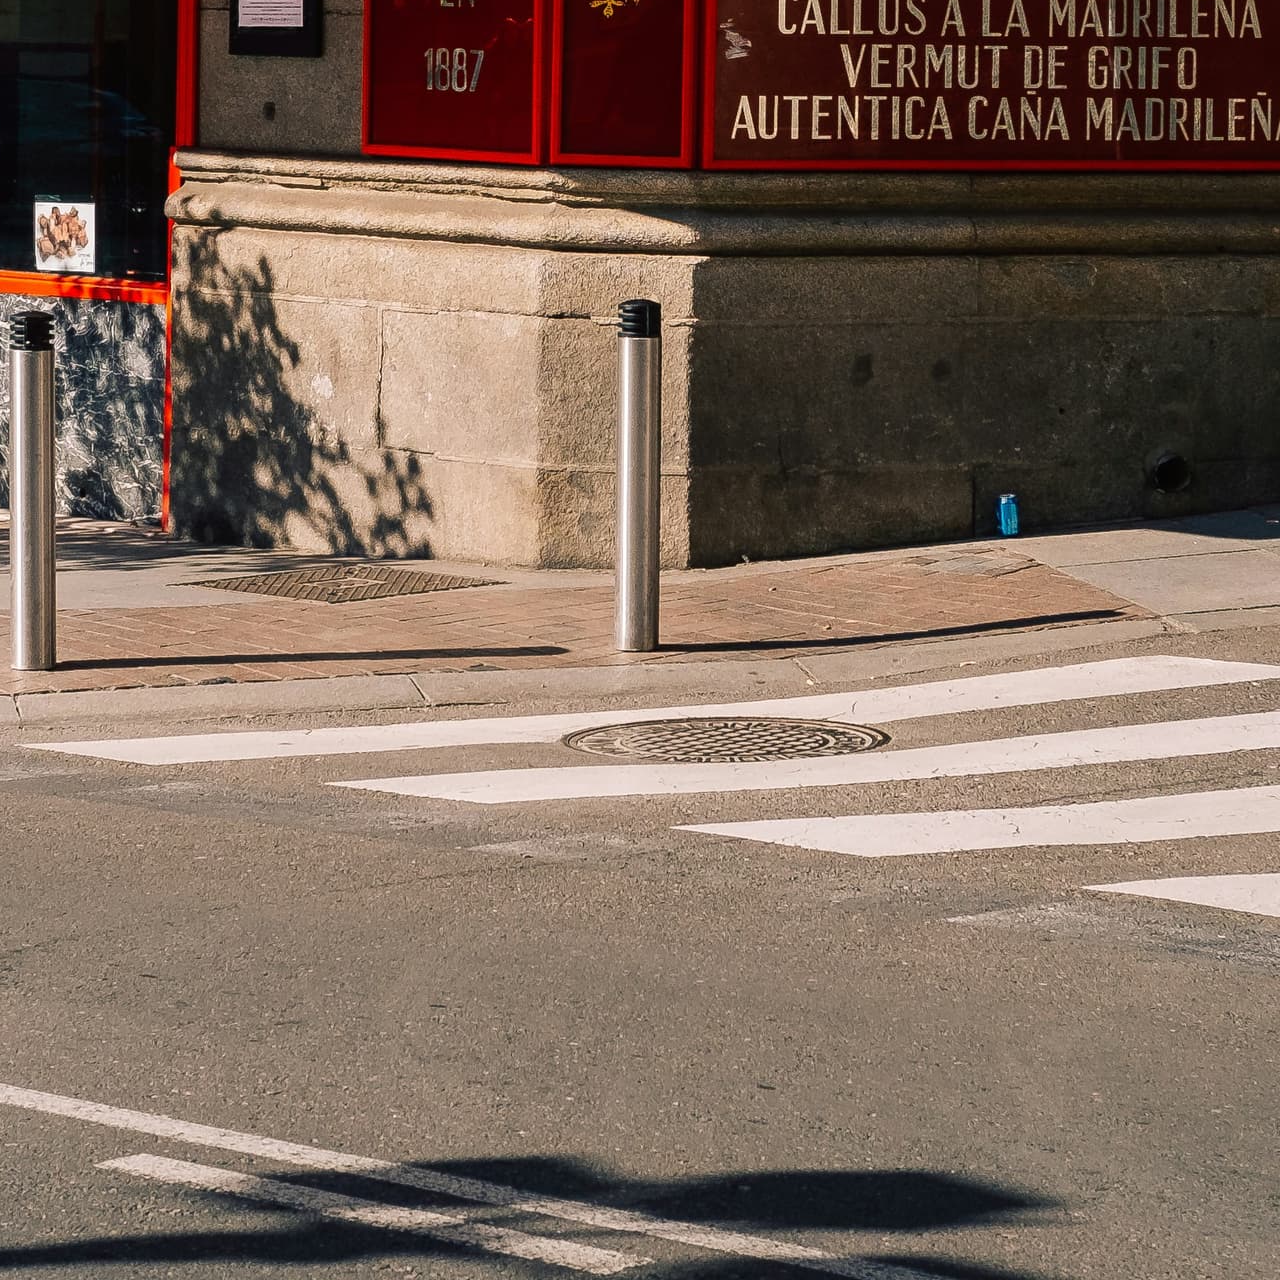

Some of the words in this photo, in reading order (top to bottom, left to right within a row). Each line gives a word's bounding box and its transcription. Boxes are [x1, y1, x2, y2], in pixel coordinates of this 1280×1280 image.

[423, 47, 485, 93] 1887
[839, 43, 1008, 90] VERMUT
[1023, 44, 1069, 90] DE
[1087, 45, 1198, 91] GRIFO
[730, 95, 953, 142] AUTENTICA
[967, 88, 1071, 142] CAÑA
